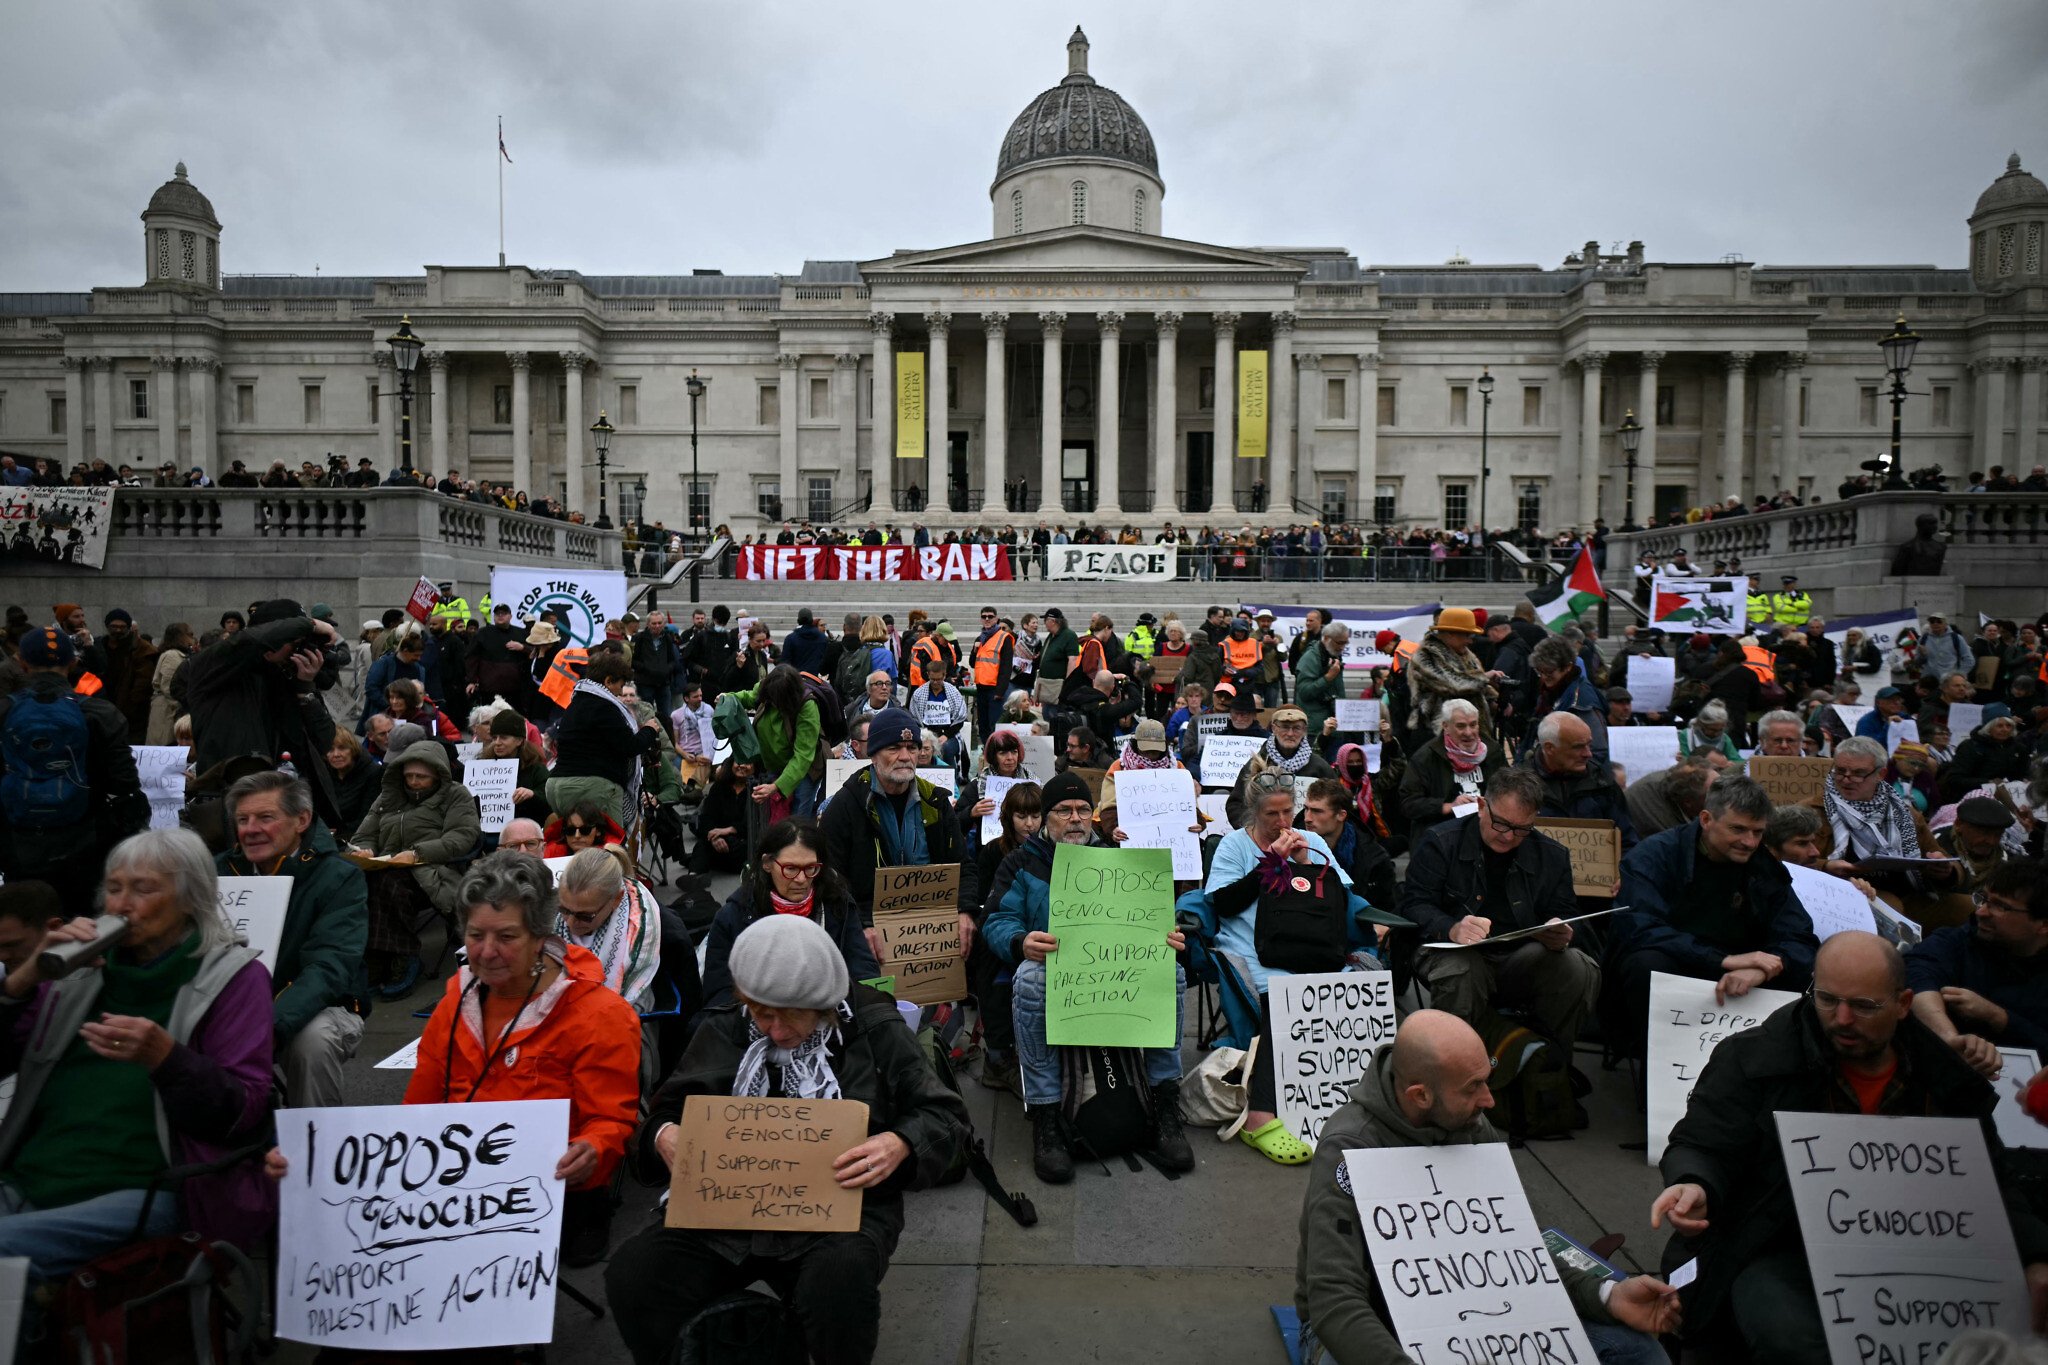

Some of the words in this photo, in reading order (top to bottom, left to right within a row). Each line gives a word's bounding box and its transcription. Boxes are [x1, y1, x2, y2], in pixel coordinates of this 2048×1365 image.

[962, 286, 998, 297] THE
[1008, 286, 1105, 297] NATIONAL
[1118, 286, 1202, 297] GALLERY
[912, 371, 920, 420] GALLERY
[1246, 370, 1254, 418] NATIONAL
[1254, 370, 1263, 418] GALLERY
[745, 546, 821, 581] LIFT
[834, 548, 904, 581] THE
[919, 543, 998, 581] BAN
[1064, 550, 1165, 574] PEACE
[516, 587, 542, 620] STOP
[546, 581, 579, 595] THE
[580, 590, 605, 625] WAR
[1205, 717, 1227, 725] OPPOS
[1208, 738, 1224, 746] This
[1225, 739, 1240, 748] Jew
[1210, 749, 1230, 757] Gaza
[469, 779, 508, 787] GENOCIDE
[472, 768, 475, 777] I
[482, 766, 513, 776] OPPOSE
[1121, 783, 1178, 798] OPPOSE
[1760, 781, 1825, 796] GENOCID
[480, 815, 504, 823] TION
[1131, 801, 1193, 817] GENOCIDE
[883, 875, 888, 891] I
[894, 868, 952, 890] OPPOSE
[1064, 862, 1070, 890] I
[1075, 867, 1173, 895] OPPOSE
[879, 888, 957, 909] GENOCIDE
[1051, 900, 1166, 922] GENOCIDE
[882, 928, 888, 943] I
[898, 921, 959, 938] SUPPORT
[893, 938, 961, 959] PALESTINE
[1055, 938, 1060, 965] I
[1078, 941, 1169, 966] SUPPORT
[903, 958, 953, 976] ACTION
[1054, 966, 1146, 991] PALESTINE
[1064, 987, 1140, 1008] ACTION
[1286, 987, 1290, 1014] I
[1302, 981, 1390, 1013] OPPOSE
[1290, 1014, 1396, 1044] GENOCIDE
[1670, 1010, 1691, 1026] I
[1700, 1012, 1757, 1029] OPPO
[1281, 1051, 1285, 1080] I
[1297, 1046, 1373, 1077] SUPPO
[1672, 1063, 1697, 1081] I
[1284, 1078, 1360, 1112] PALEST
[707, 1105, 710, 1121] I
[724, 1102, 812, 1122] OPPOSE
[308, 1120, 316, 1188] I
[334, 1122, 516, 1191] OPPOSE
[701, 1150, 706, 1173] I
[717, 1154, 800, 1172] SUPPORT
[1791, 1135, 1836, 1175] I
[1849, 1141, 1967, 1176] OPPOSE
[696, 1177, 808, 1202] PALESTINE
[1424, 1164, 1442, 1196] I
[361, 1187, 538, 1240] GENOCIDE
[1372, 1196, 1515, 1241] OPPOSE
[1827, 1188, 1975, 1238] GENOCIDE
[289, 1256, 297, 1297] I
[305, 1254, 424, 1302] SUPPORT
[1392, 1247, 1560, 1298] GENOCIDE
[308, 1288, 425, 1336] PALESTINE
[438, 1247, 558, 1323] ACTION
[1822, 1288, 1855, 1324] I
[1874, 1287, 2001, 1328] SUPPORT
[1447, 1327, 1579, 1365] SUPPORT
